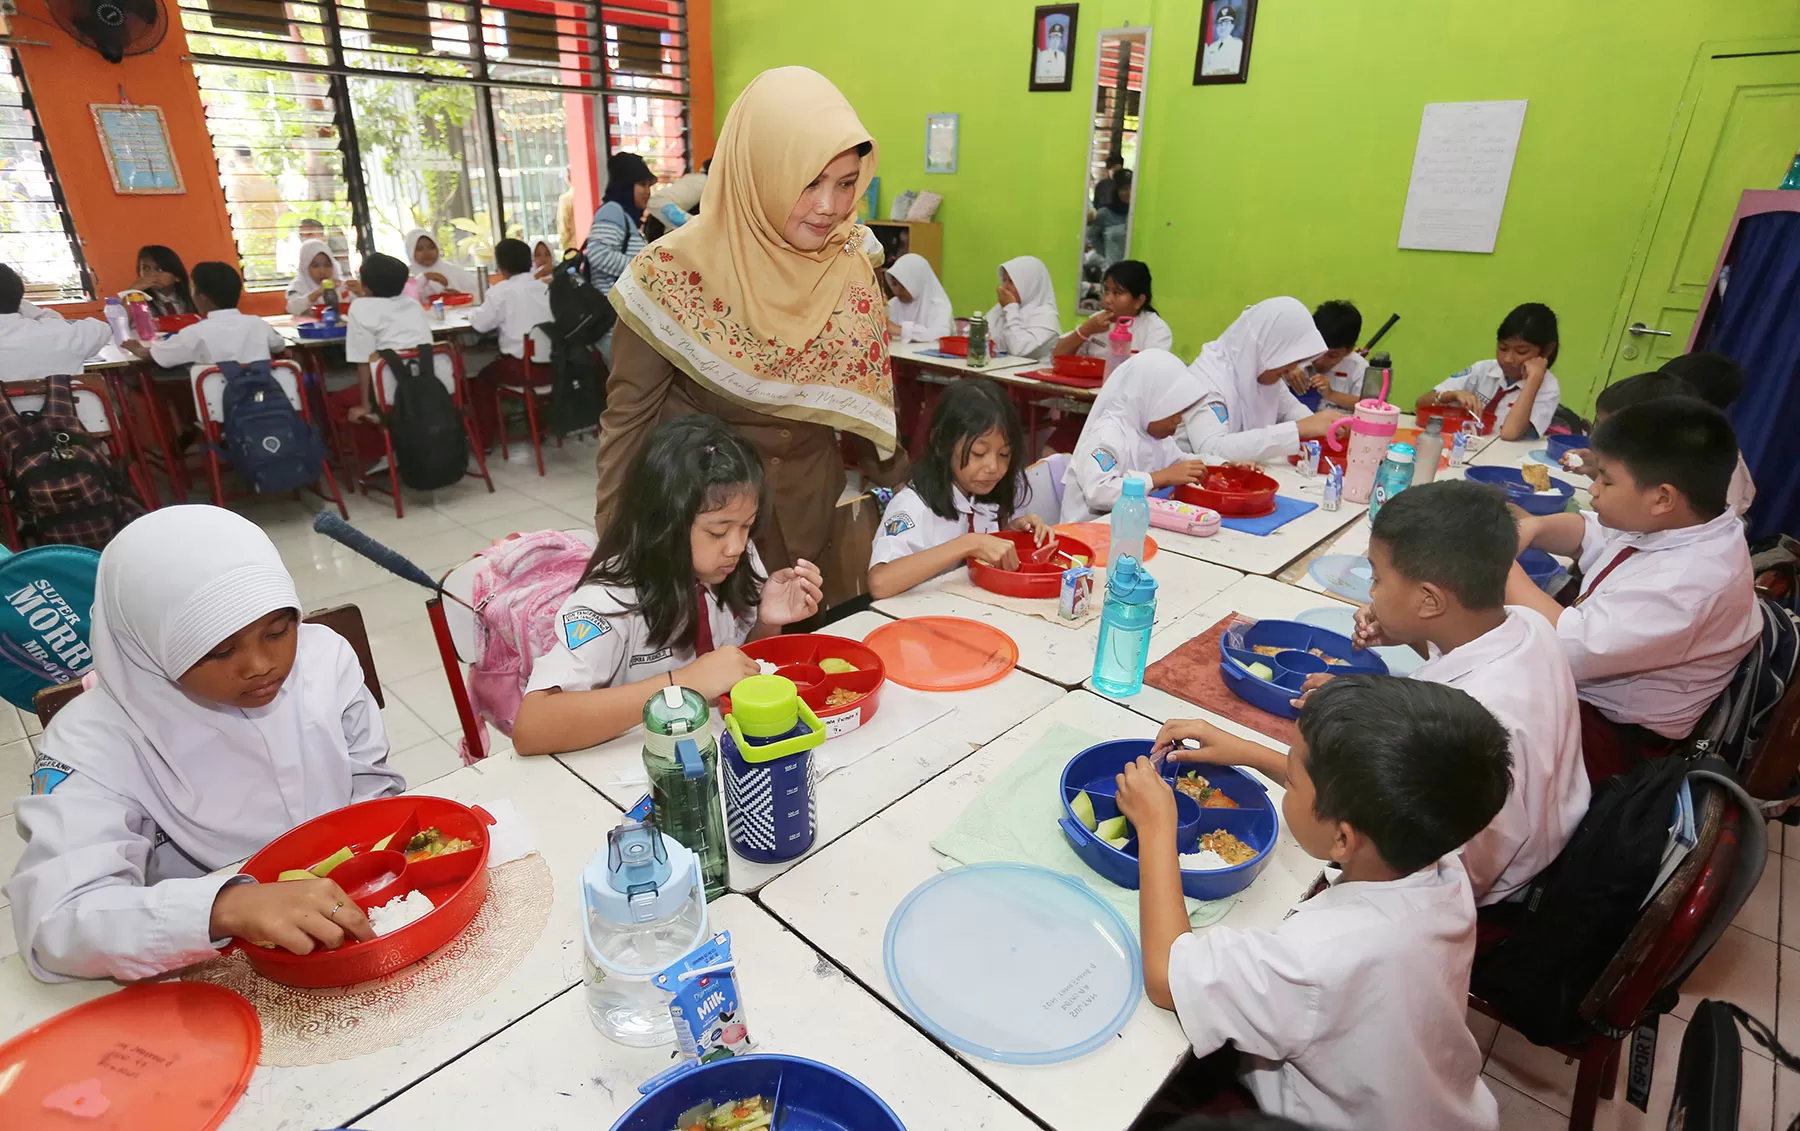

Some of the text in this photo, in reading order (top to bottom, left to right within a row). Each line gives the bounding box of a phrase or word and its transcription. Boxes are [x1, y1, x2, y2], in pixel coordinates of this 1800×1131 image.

[34, 579, 81, 626] SUPER
[22, 639, 70, 685] MB-012
[697, 991, 726, 1020] Milk
[1633, 1028, 1653, 1087] SPORT
